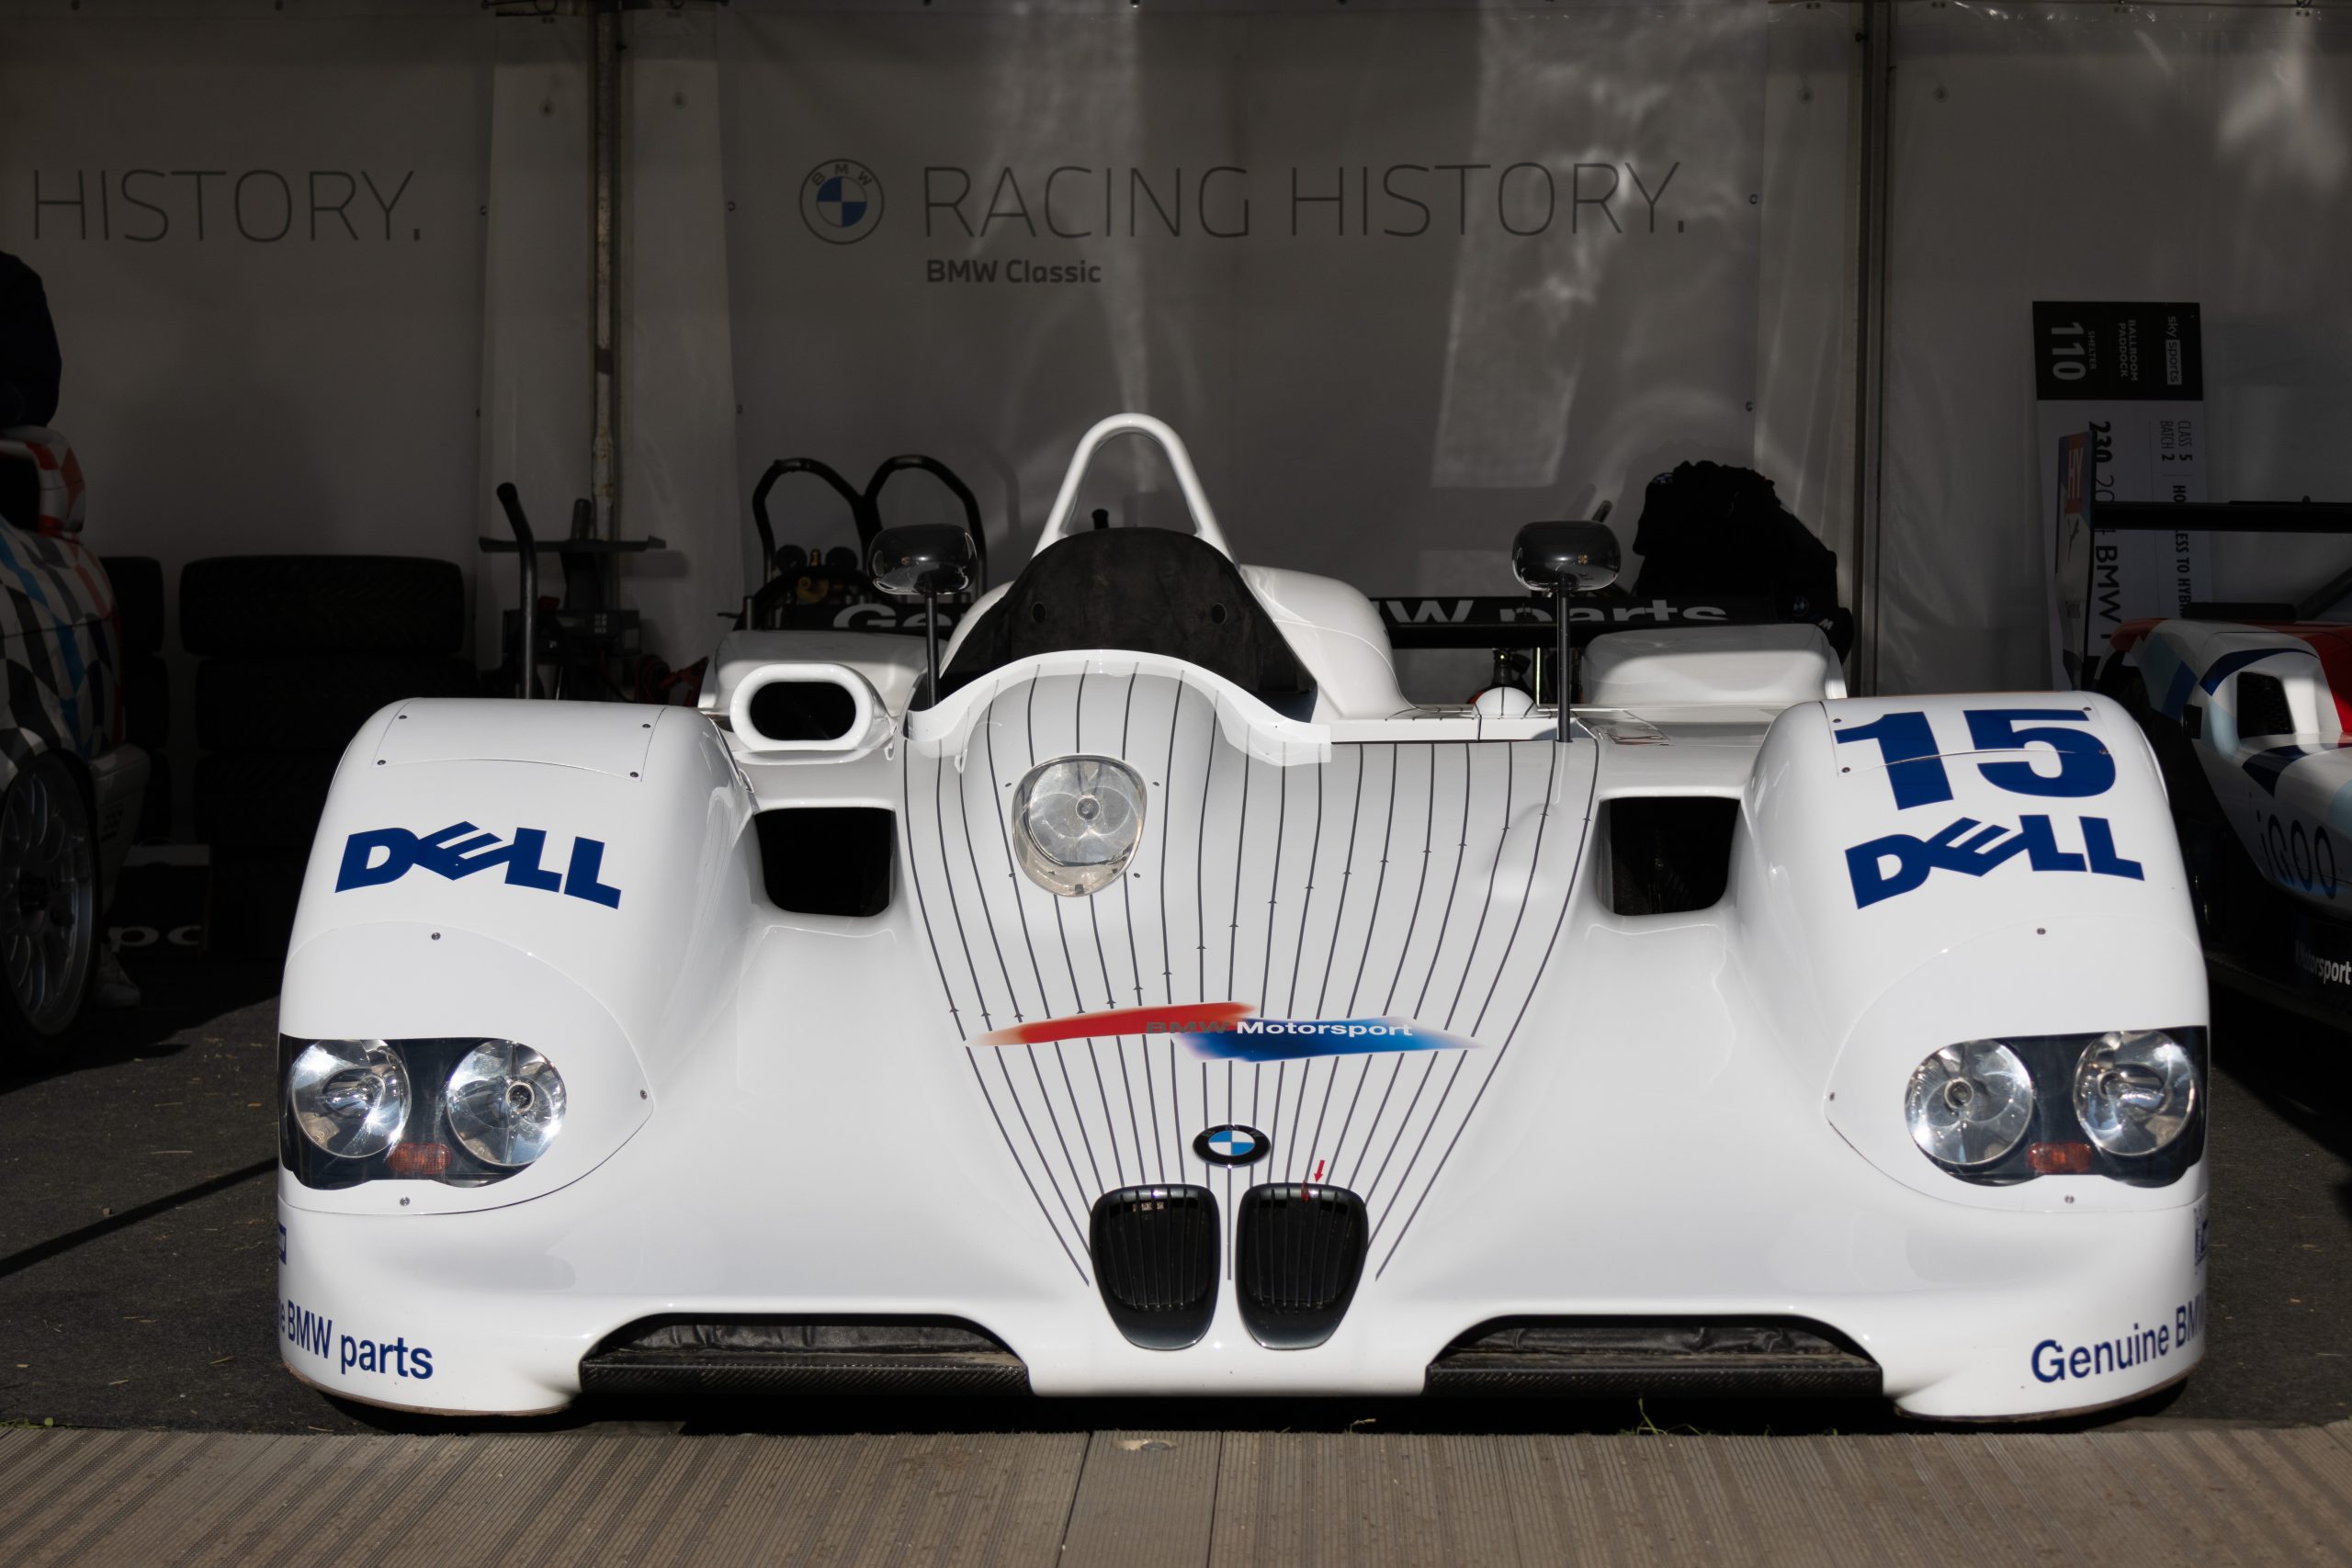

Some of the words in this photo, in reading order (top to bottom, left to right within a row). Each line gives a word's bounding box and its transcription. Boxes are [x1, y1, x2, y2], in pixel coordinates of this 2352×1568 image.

[811, 164, 873, 186] BMW
[33, 168, 421, 243] HISTORY.
[922, 165, 1250, 239] RACING
[1291, 161, 1685, 238] HISTORY.
[926, 259, 998, 284] BMW
[1005, 258, 1102, 285] Classic
[2165, 315, 2180, 338] sky
[2050, 321, 2087, 381] 110
[2086, 330, 2098, 370] SHELTER
[2117, 322, 2129, 378] PADDOCK
[2127, 319, 2140, 382] BALLROOM
[2166, 341, 2180, 384] sports
[2089, 421, 2112, 463] 230
[2160, 420, 2175, 449] BATCH
[2177, 420, 2192, 447] CLASS
[2161, 454, 2176, 462] 2
[2178, 454, 2193, 462] 5
[2096, 545, 2122, 624] BMW
[2177, 558, 2190, 574] TO
[1833, 708, 2117, 811] 15
[334, 820, 622, 910] DELL
[1844, 814, 2145, 910] DELL
[1145, 1021, 1234, 1034] BMW
[1237, 1021, 1414, 1038] Motorsport
[287, 1299, 333, 1359] BMW
[341, 1334, 434, 1380] parts
[2030, 1323, 2169, 1383] Genuine
